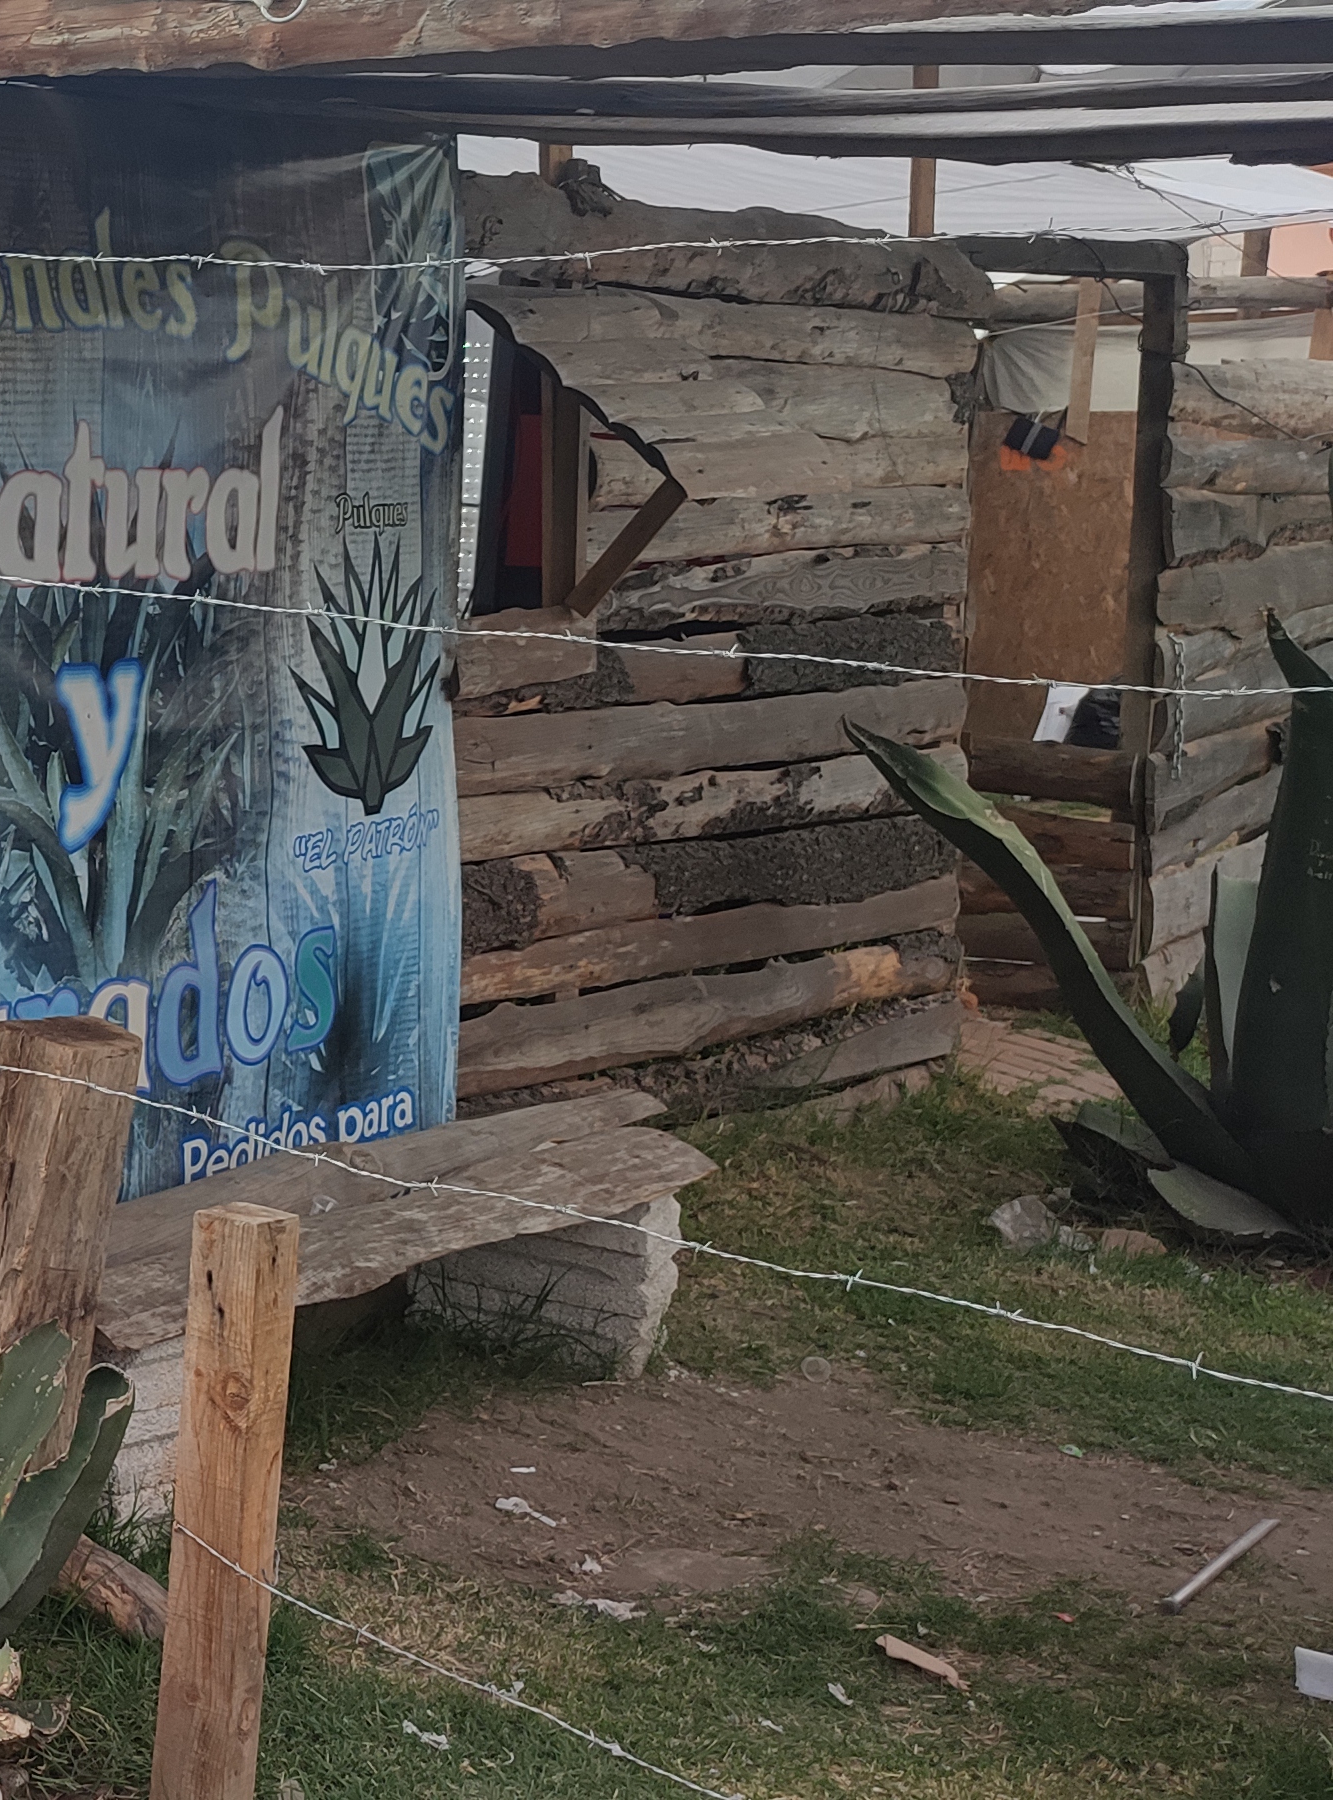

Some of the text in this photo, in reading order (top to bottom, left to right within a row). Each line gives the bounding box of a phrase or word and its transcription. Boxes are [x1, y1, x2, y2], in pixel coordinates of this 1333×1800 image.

[218, 237, 456, 456] Pulques
[335, 490, 409, 536] Pulques
[56, 657, 143, 854] y
[294, 801, 440, 872] "EL PATRÓN"
[183, 1090, 414, 1184] Pedidos para
